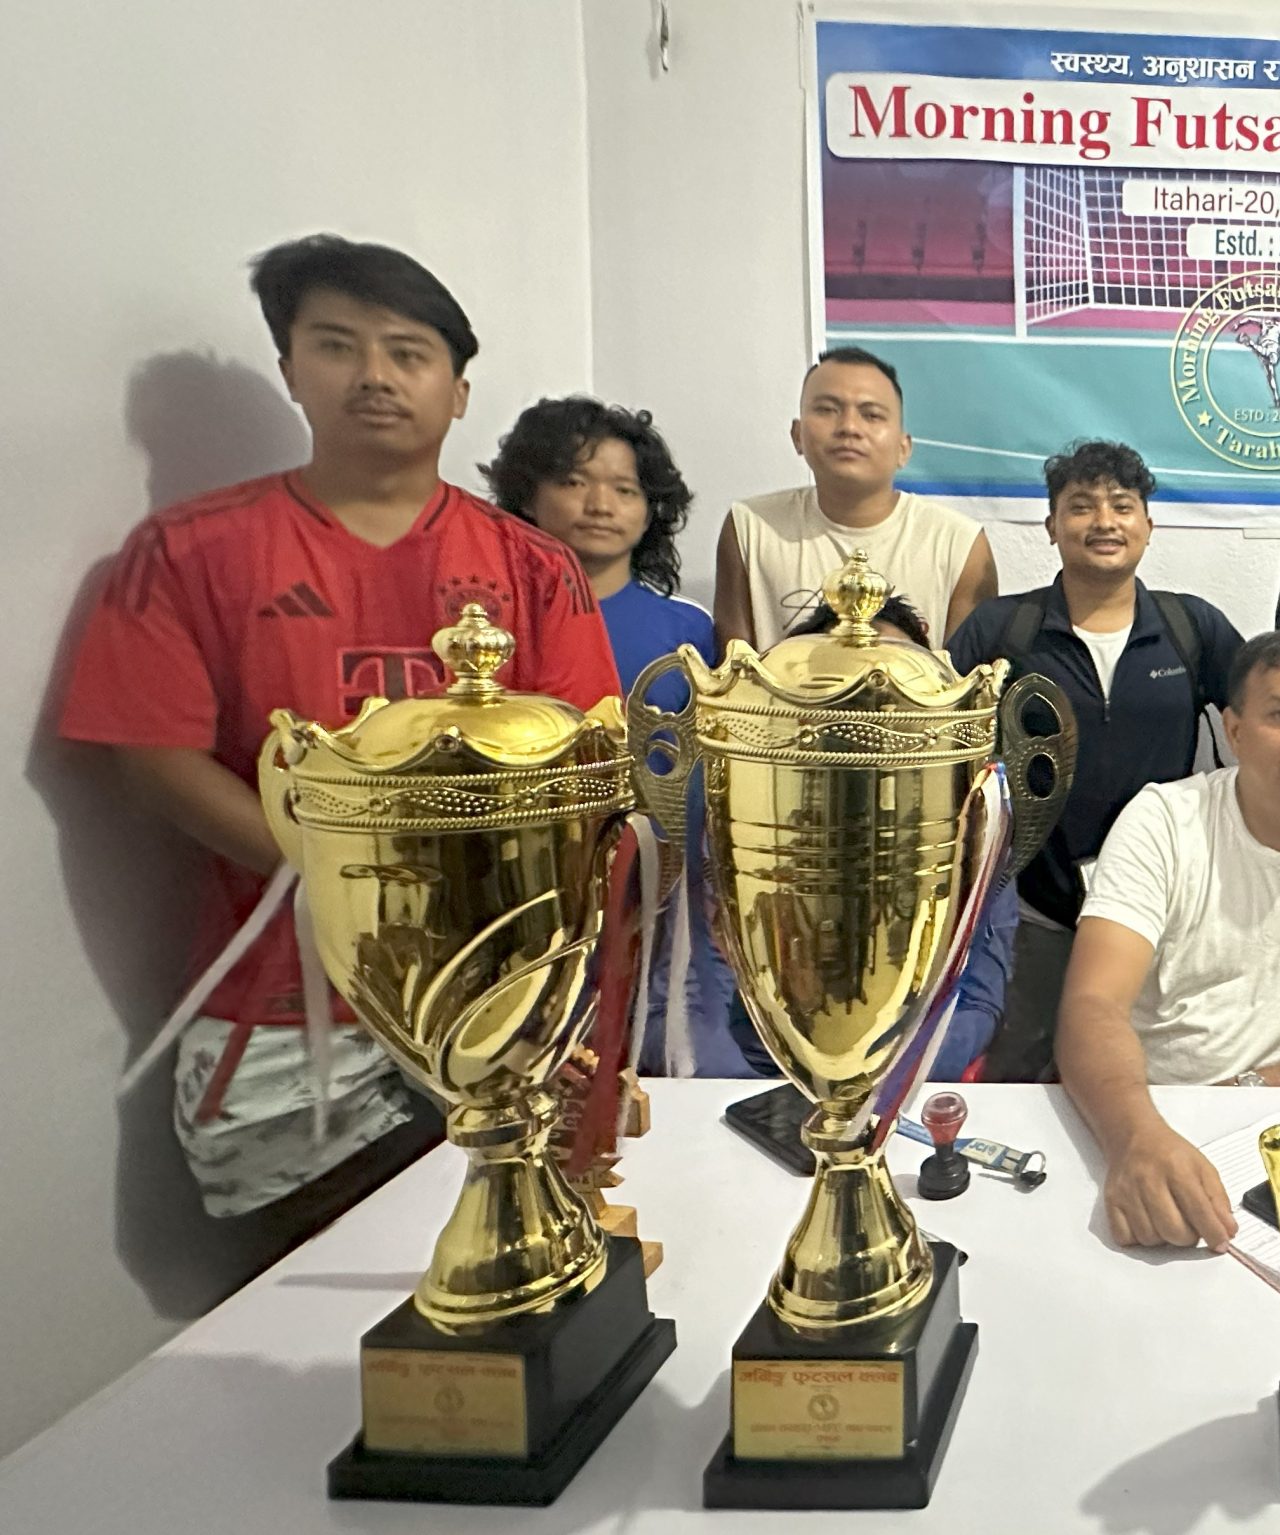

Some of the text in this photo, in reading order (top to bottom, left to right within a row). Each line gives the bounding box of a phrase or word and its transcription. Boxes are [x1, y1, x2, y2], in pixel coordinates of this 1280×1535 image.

[1050, 52, 1134, 78] स्वस्थ्य,
[1143, 55, 1257, 83] अनुशासन
[1263, 60, 1280, 81] र
[848, 84, 1111, 160] Morning
[1153, 185, 1280, 218] Itahari-20,
[1215, 229, 1263, 256] Estd.
[1177, 307, 1221, 406] Morning
[968, 1141, 989, 1153] JCI
